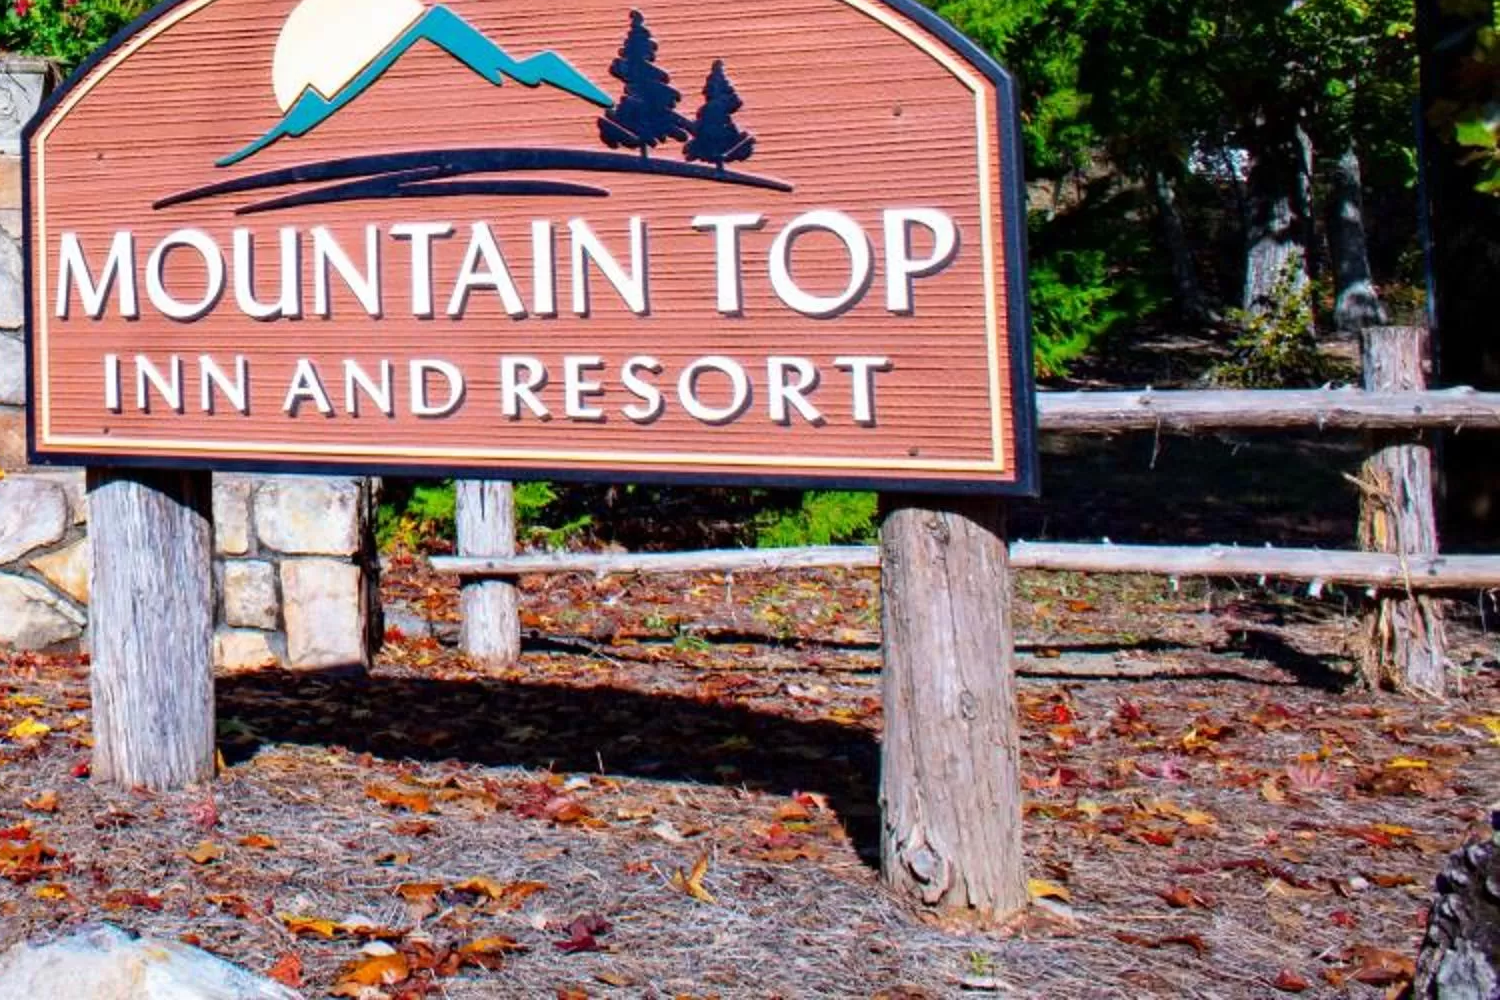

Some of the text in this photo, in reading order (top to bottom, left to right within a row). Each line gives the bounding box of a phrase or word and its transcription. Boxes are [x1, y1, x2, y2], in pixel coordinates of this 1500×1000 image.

[54, 207, 959, 320] MOUNTAIN TOP
[104, 354, 892, 426] INN AND RESORT
